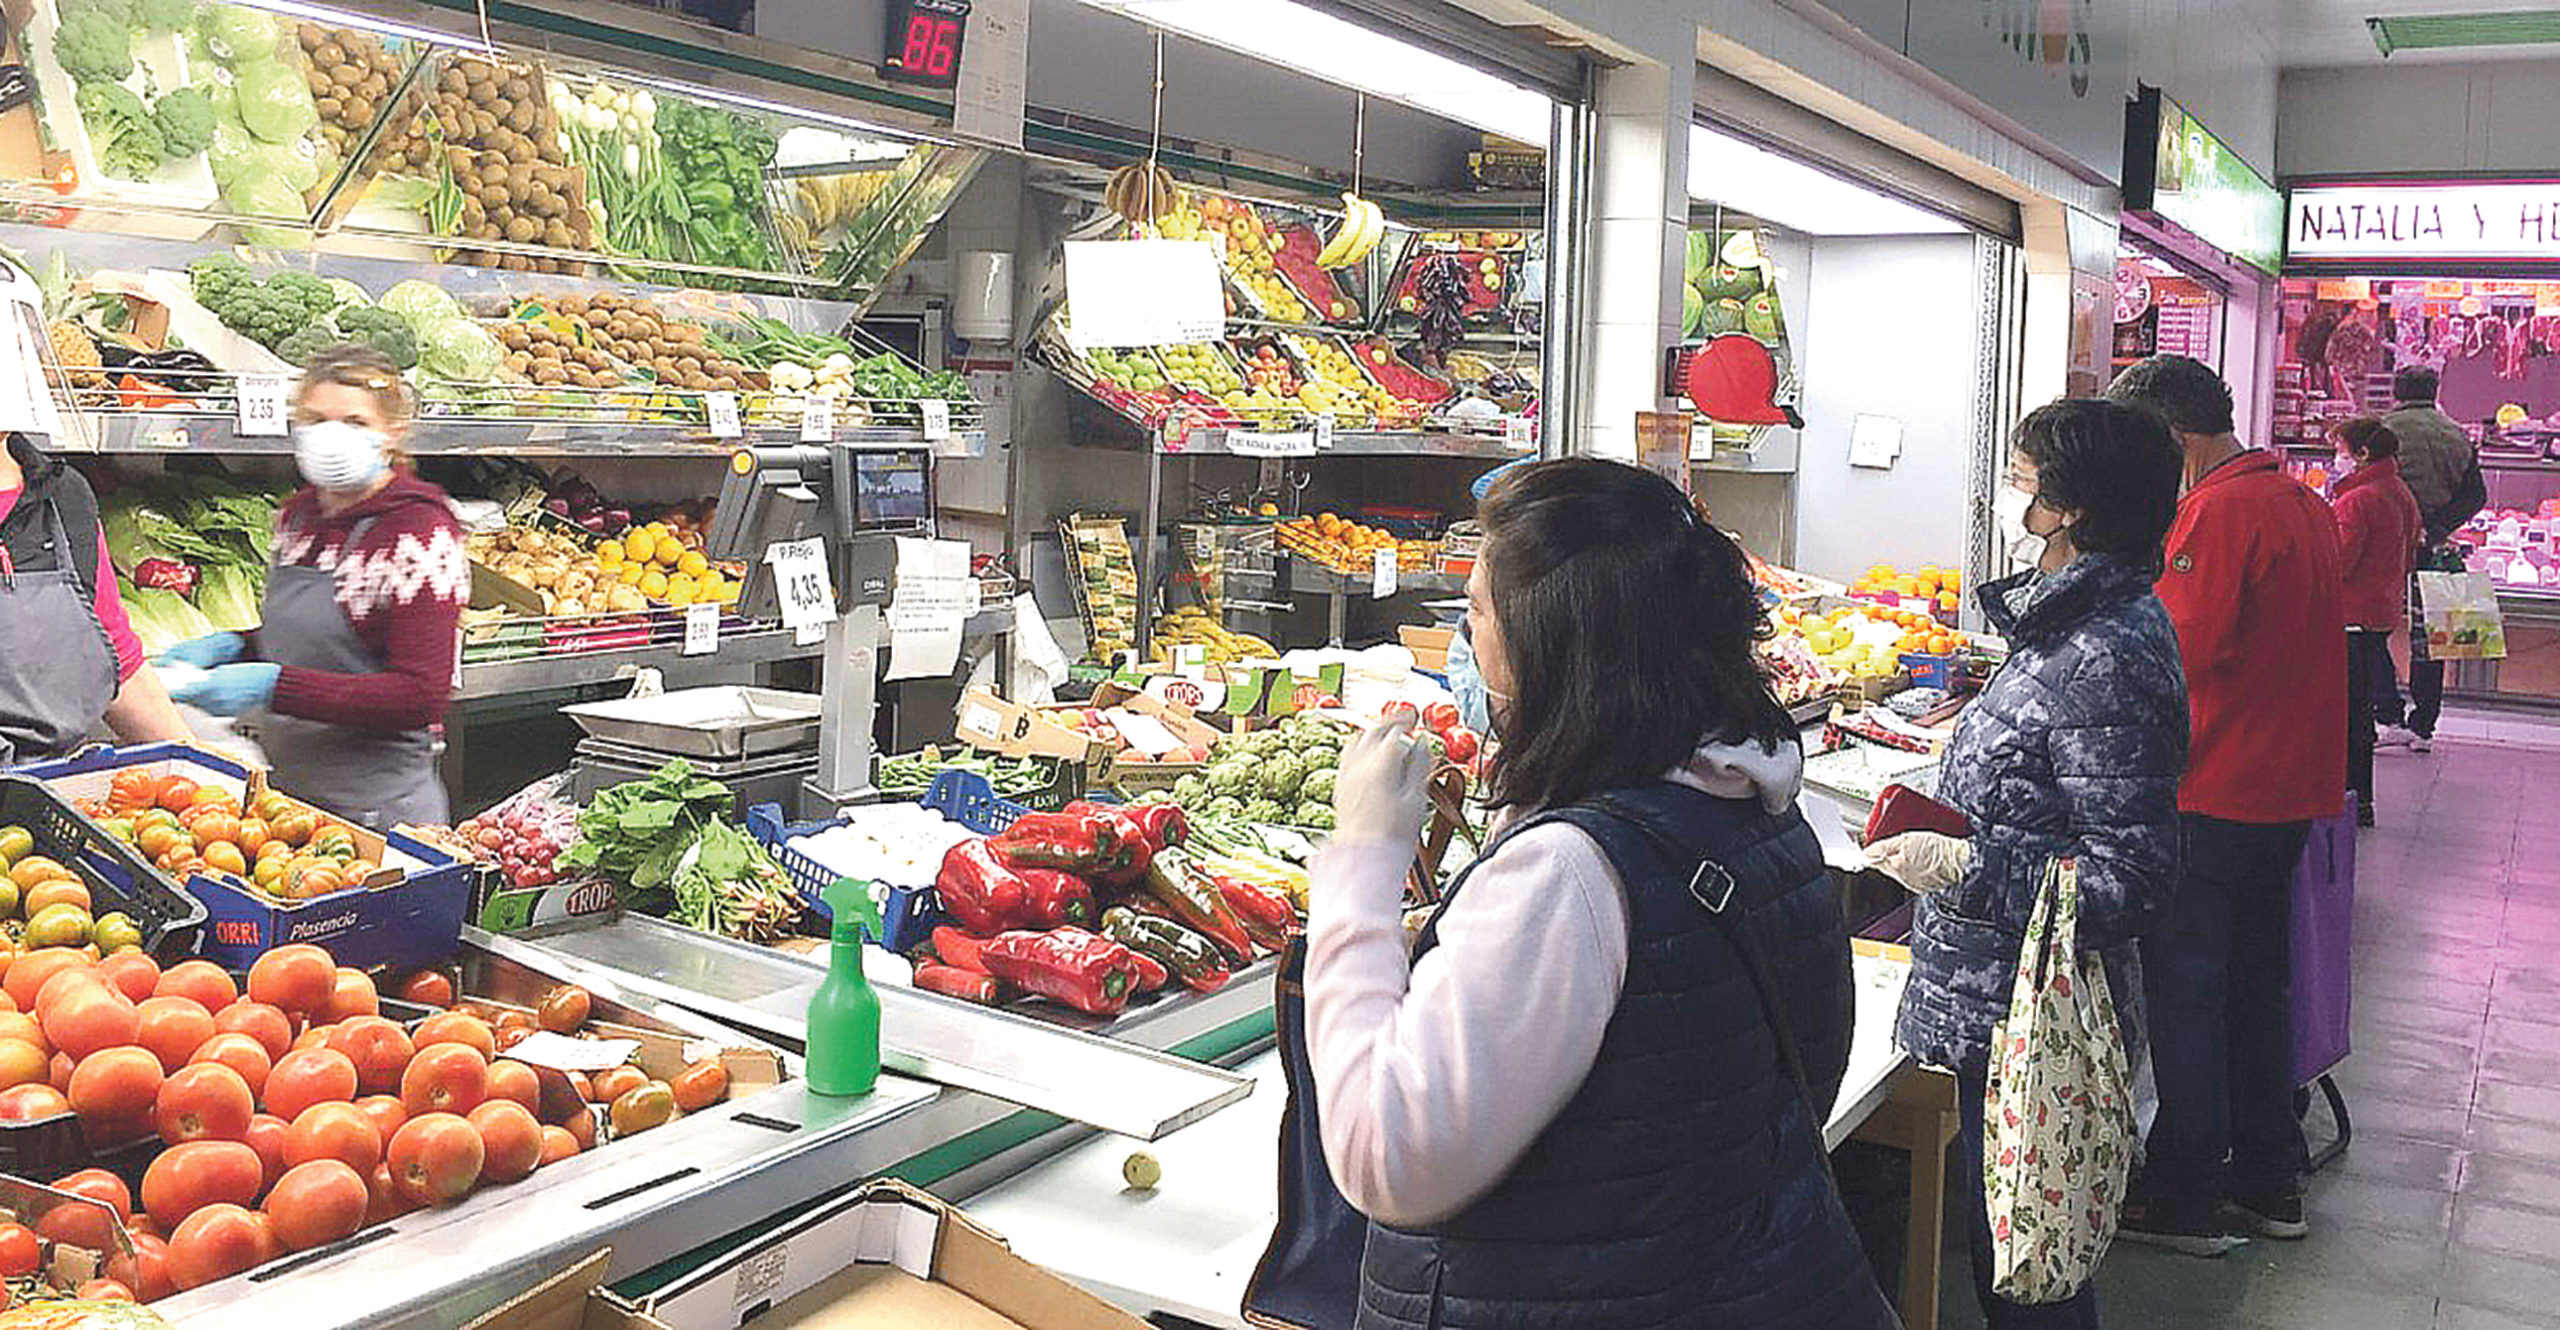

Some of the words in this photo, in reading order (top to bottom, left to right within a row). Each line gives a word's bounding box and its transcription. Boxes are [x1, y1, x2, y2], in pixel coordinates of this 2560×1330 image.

[903, 16, 958, 76] 86
[2300, 203, 2443, 242] NATALIA
[2473, 203, 2486, 240] Y
[789, 573, 823, 611] 4,35
[570, 883, 613, 913] TROP
